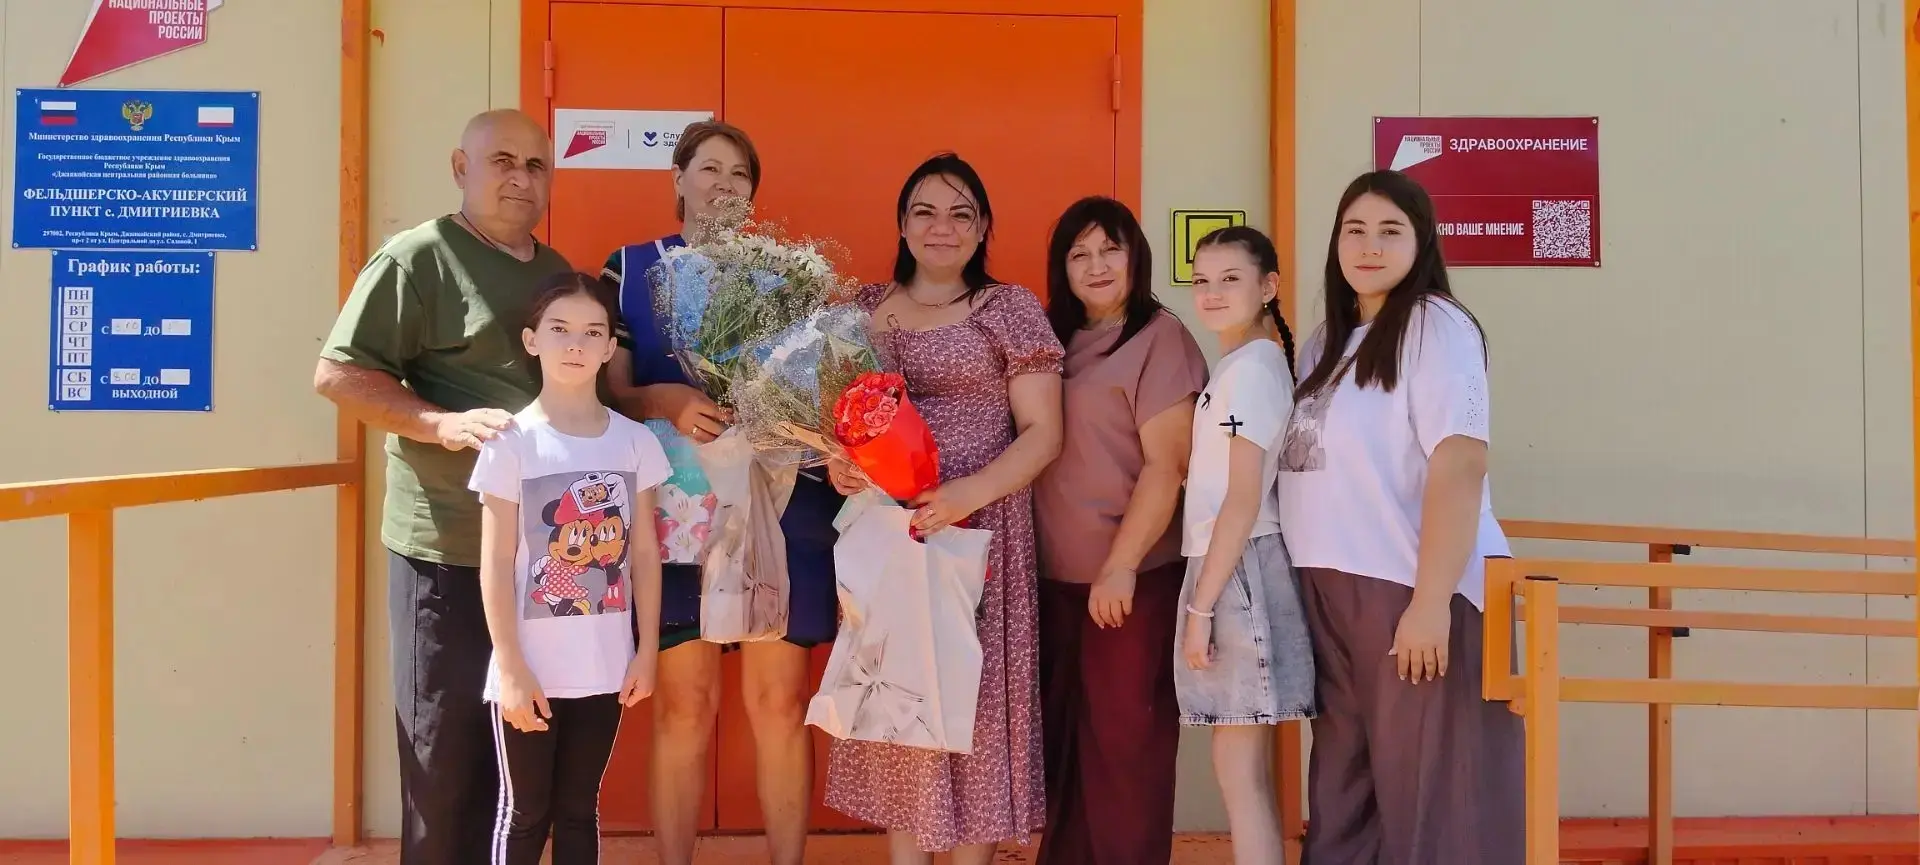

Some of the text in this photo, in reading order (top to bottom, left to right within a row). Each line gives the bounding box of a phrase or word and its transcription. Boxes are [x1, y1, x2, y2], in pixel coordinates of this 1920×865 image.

[108, 0, 204, 10] НАЦИОНАЛЬНЫЕ
[148, 11, 204, 25] ПРОЕКТЫ
[158, 25, 203, 40] РОССИИ
[28, 132, 241, 144] Министерство здравоохранения Республики Крым
[663, 132, 684, 141] Слу
[1449, 138, 1588, 154] ЗДРАВООХРАНЕНИЕ
[145, 162, 166, 171] Крым
[23, 188, 248, 202] ФЕЛЬДШЕРСКО-АКУШЕРСКИЙ
[50, 205, 220, 219] ПУНКТ с. ДМИТРИЕВКА
[1456, 223, 1484, 236] ВАШЕ
[1485, 223, 1525, 236] МНЕНИЕ
[68, 259, 200, 277] График работы:
[68, 289, 89, 300] ПН
[69, 305, 88, 316] ВТ
[69, 321, 88, 332] СР
[68, 336, 88, 348] ЧТ
[67, 352, 88, 363] ПТ
[67, 371, 87, 383] СБ
[67, 387, 87, 399] ВС
